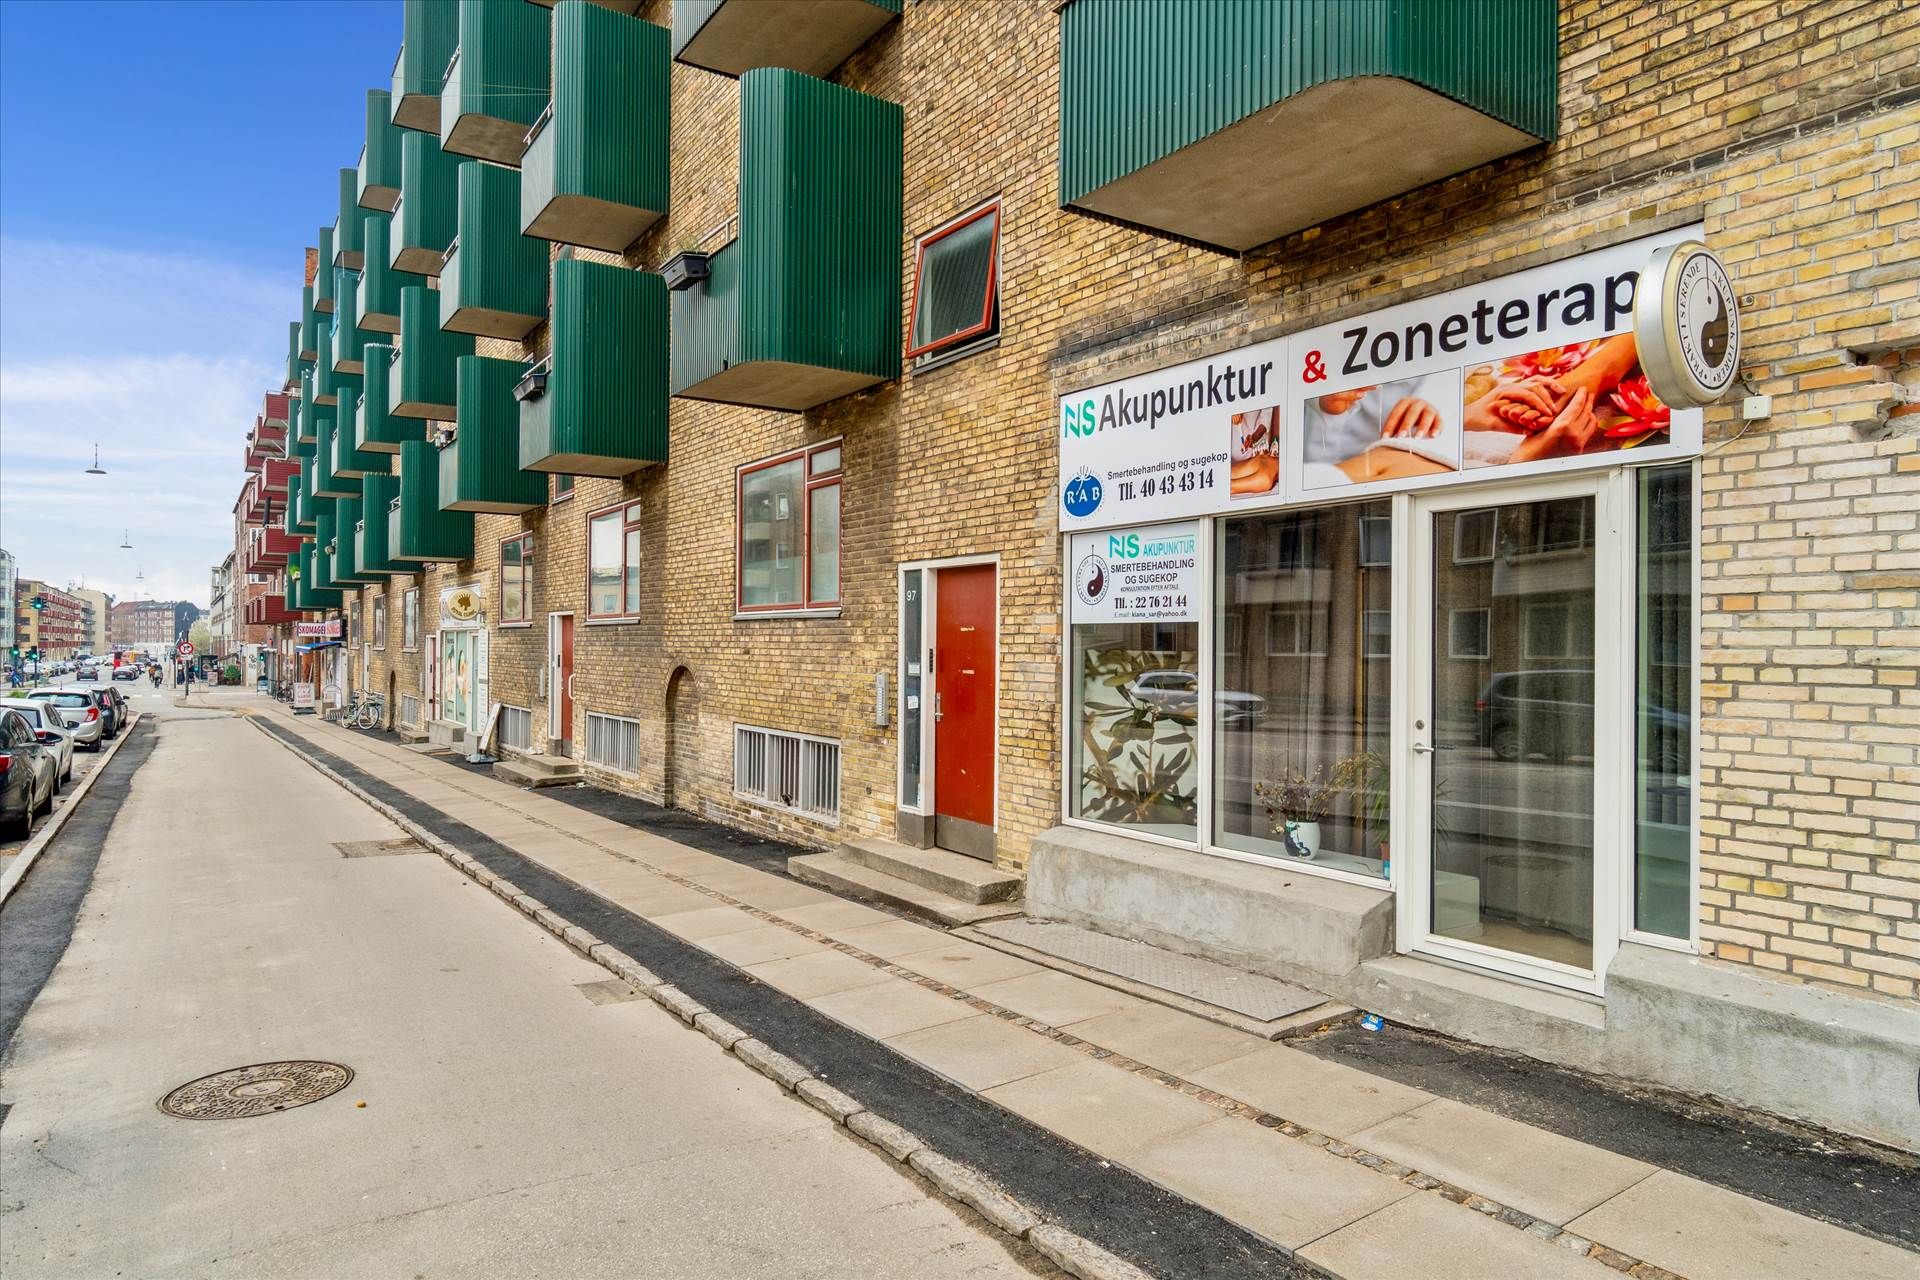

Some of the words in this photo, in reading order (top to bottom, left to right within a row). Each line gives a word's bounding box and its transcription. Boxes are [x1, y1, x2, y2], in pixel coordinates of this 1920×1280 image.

[1064, 399, 1096, 438] NS
[1099, 358, 1273, 433] Akupunktur
[1301, 350, 1327, 384] &
[1342, 266, 1642, 376] Zoneterap
[1107, 460, 1176, 481] Smertebehandling
[1178, 459, 1189, 469] og
[1191, 451, 1229, 467] sugekop
[1118, 481, 1137, 502] Tlf.
[1140, 478, 1156, 498] 40
[1159, 475, 1175, 495] 43
[1179, 472, 1195, 491] 43
[1199, 468, 1214, 489] 14
[1109, 533, 1140, 559] NS
[1143, 539, 1195, 557] AKUPUNKTUR
[1110, 558, 1195, 573] SMERTEBEHANDLING
[1125, 575, 1137, 585] OG
[1138, 572, 1178, 583] SUGEKOP
[906, 590, 917, 602] 97
[1135, 596, 1147, 609] 22
[1149, 595, 1160, 608] 76
[1162, 595, 1172, 608] 21
[1175, 594, 1187, 607] 44
